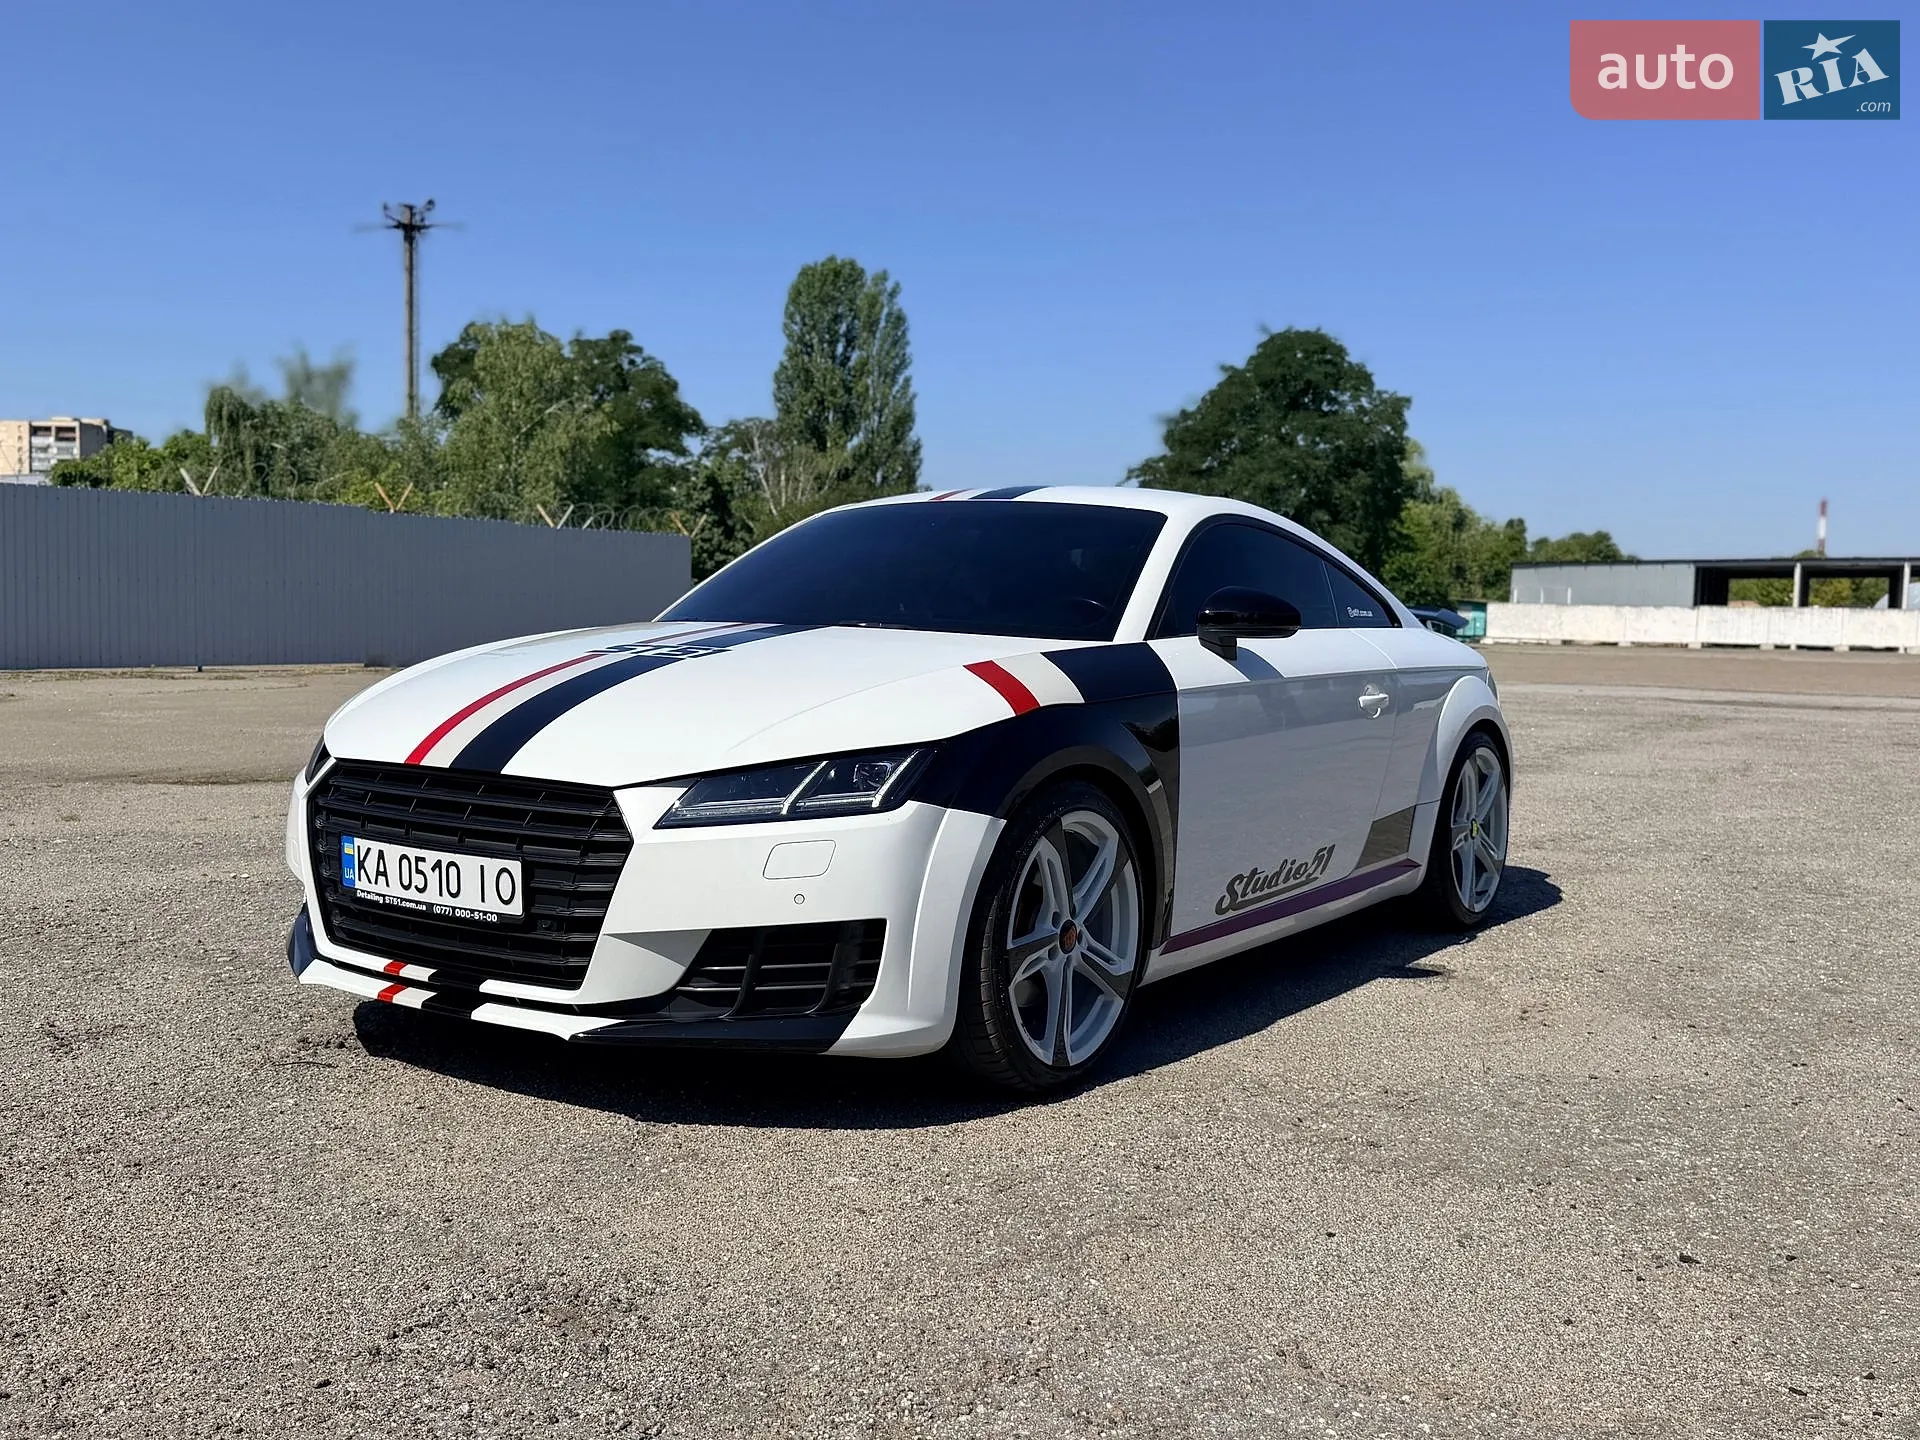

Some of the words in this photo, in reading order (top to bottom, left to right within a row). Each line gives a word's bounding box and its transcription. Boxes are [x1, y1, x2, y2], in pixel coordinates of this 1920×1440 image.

[344, 867, 355, 881] UA
[357, 845, 390, 888] KA
[398, 853, 461, 899] 0510
[479, 864, 516, 906] IO
[1215, 844, 1336, 915] Studio51
[356, 889, 384, 904] Detailing
[385, 896, 427, 911] ST51.com.ua
[433, 904, 453, 917] (077)
[455, 908, 498, 922] 000-51-00
